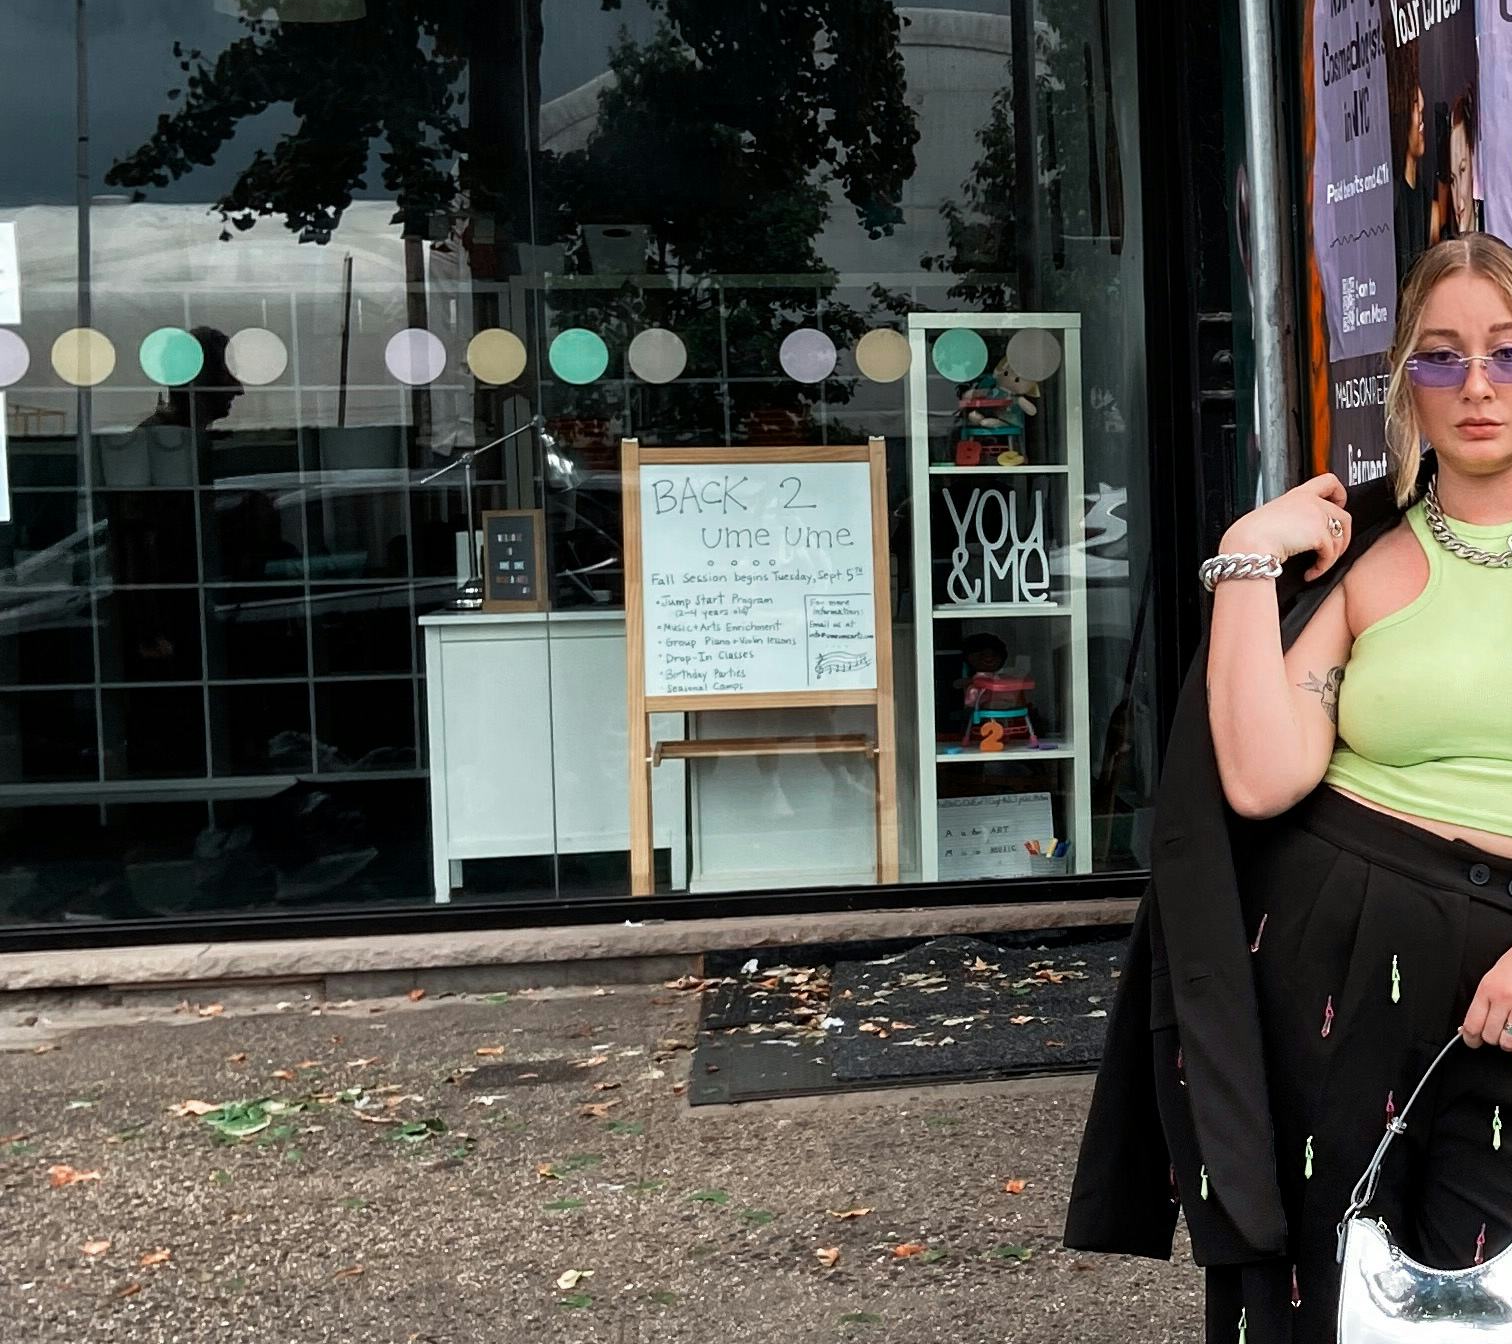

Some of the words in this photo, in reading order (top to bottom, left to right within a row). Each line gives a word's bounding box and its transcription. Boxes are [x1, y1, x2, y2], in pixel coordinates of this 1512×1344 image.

[651, 476, 748, 515] BACK
[779, 476, 817, 509] 2
[942, 487, 1045, 550] YOU
[651, 572, 674, 586] Fall
[683, 572, 727, 583] Session
[734, 570, 768, 586] begins
[817, 569, 842, 586] Sept
[661, 594, 691, 608] Jump
[696, 592, 725, 605] Start
[732, 593, 773, 608] Program
[665, 638, 697, 649] Group
[713, 667, 747, 679] Parties
